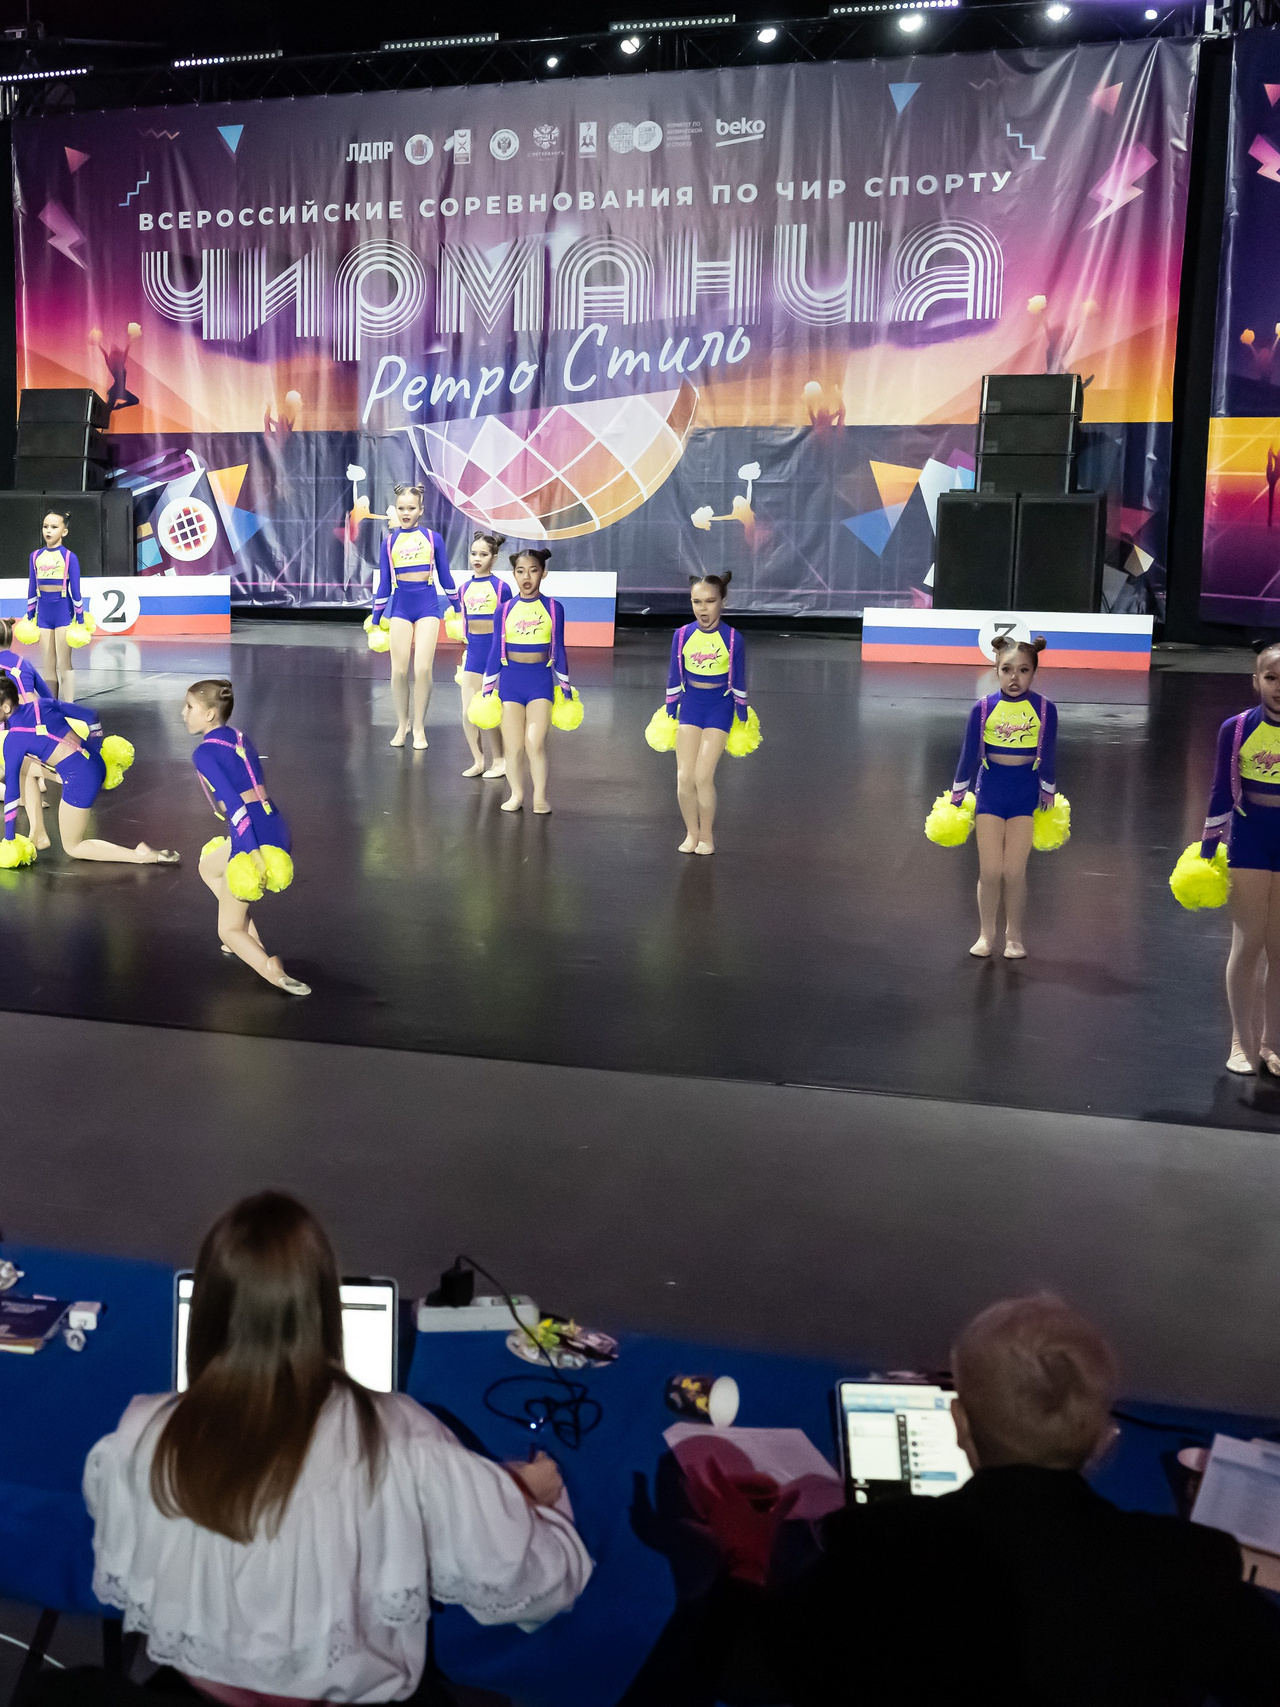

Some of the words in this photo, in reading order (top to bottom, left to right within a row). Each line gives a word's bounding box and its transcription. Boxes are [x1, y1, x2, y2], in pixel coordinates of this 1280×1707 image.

[716, 117, 766, 136] beko
[346, 141, 394, 164] ЛДПР
[139, 199, 404, 231] ВСЕРОССИЙСКИЕ
[419, 187, 694, 218] СОРЕВНОВАНИЯ
[711, 182, 760, 205] ПО
[777, 178, 848, 202] ЧИР
[865, 171, 1013, 199] СПОРТУ
[363, 353, 538, 423] Ретро
[562, 323, 752, 392] Стиль
[101, 589, 127, 624] 2
